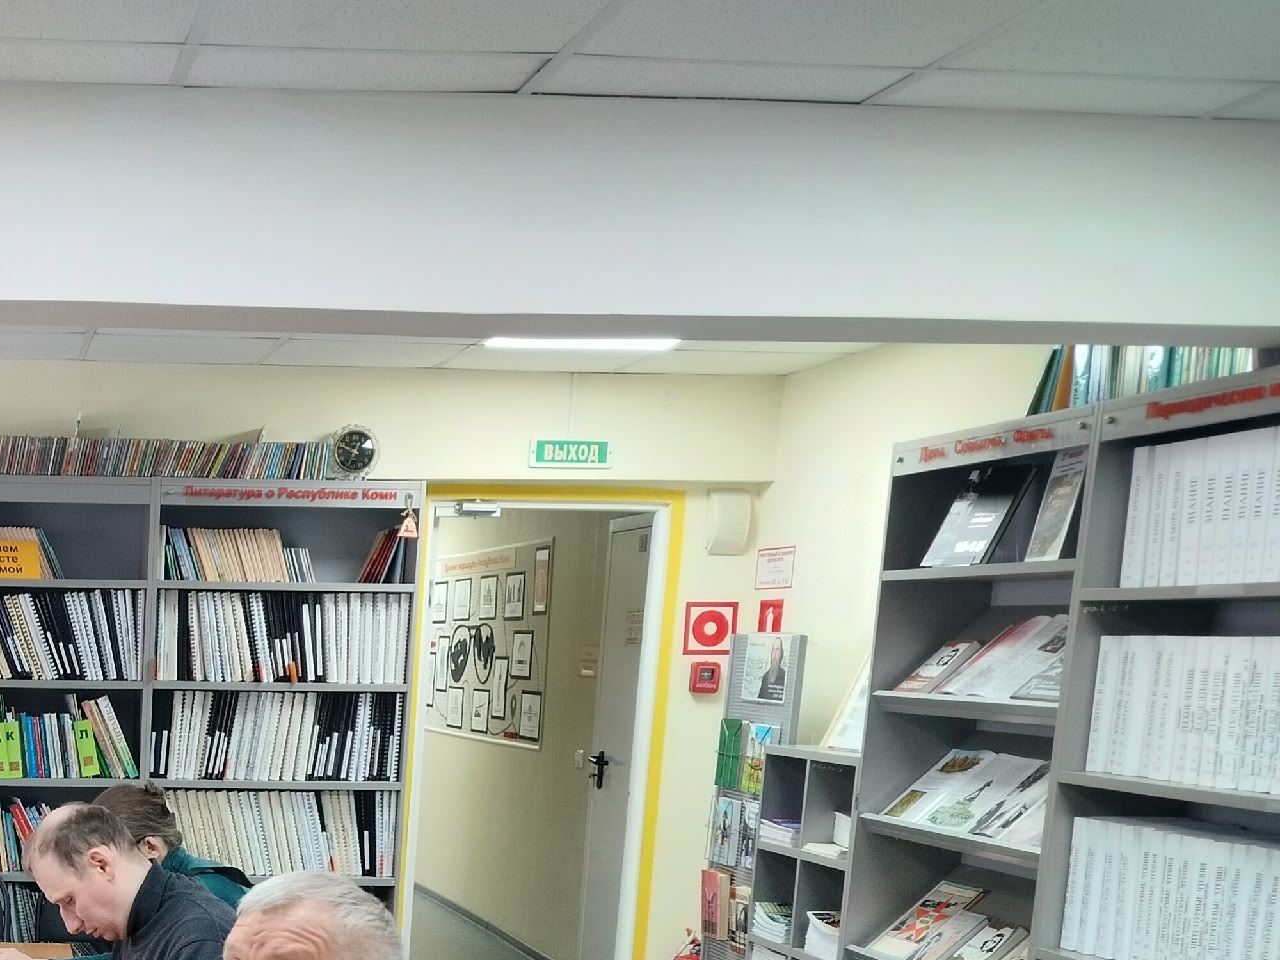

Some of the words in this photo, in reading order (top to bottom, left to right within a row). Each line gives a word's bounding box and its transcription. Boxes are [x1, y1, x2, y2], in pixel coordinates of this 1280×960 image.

[543, 444, 599, 463] ВЫХОД
[183, 485, 263, 501] Литература
[266, 490, 274, 498] о
[278, 487, 359, 501] Республике
[361, 488, 398, 501] Коми
[6, 731, 15, 741] К
[79, 729, 89, 739] Л
